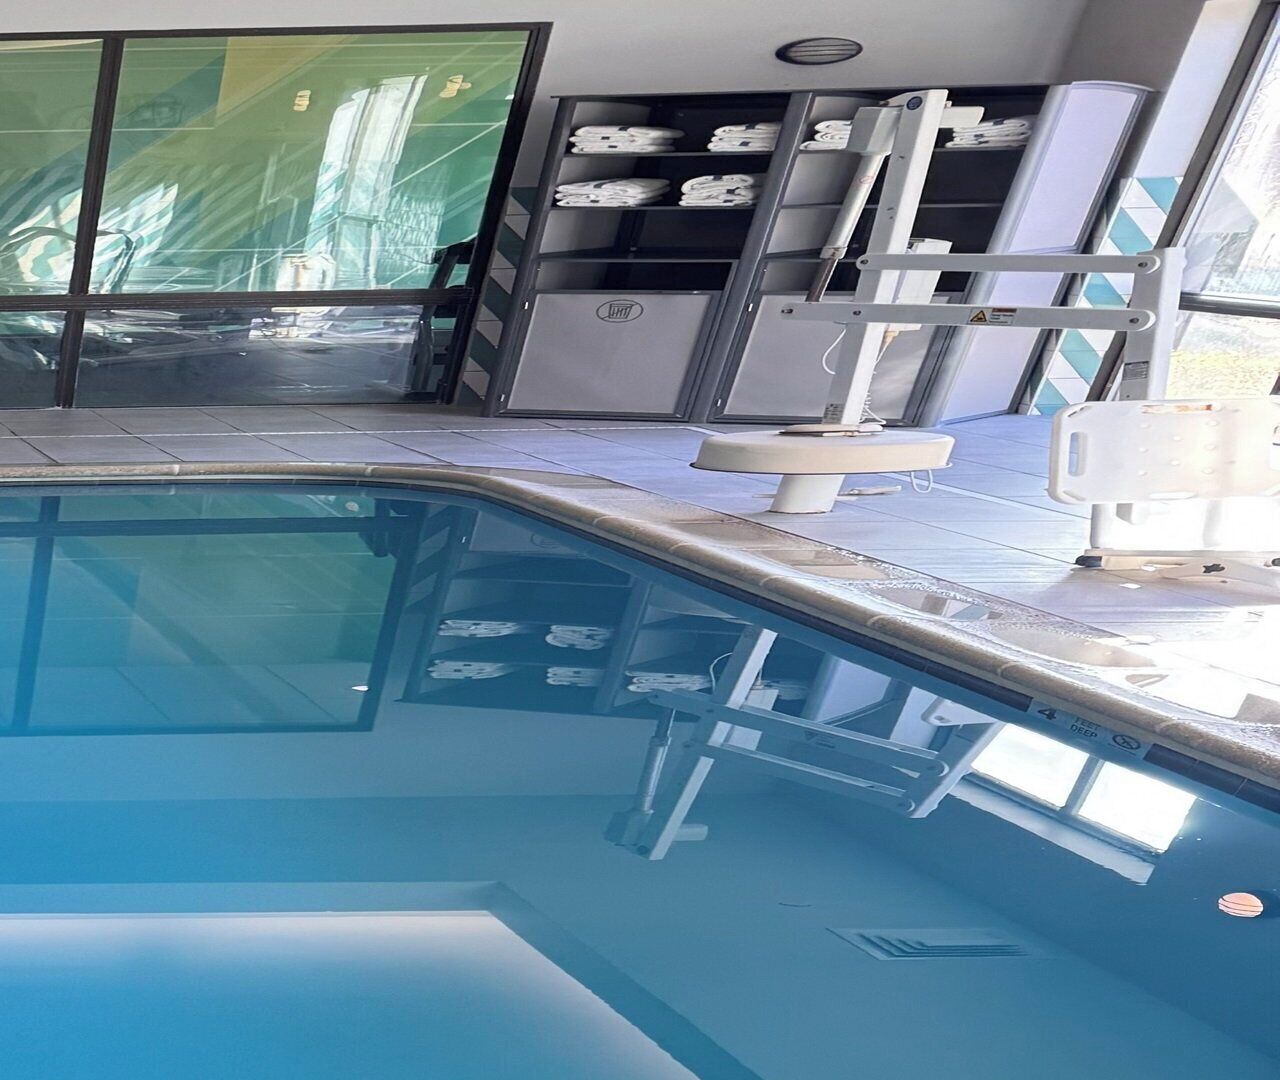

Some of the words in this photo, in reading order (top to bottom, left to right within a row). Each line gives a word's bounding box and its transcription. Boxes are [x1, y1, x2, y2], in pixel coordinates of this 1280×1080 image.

[1037, 708, 1057, 720] 4
[1074, 717, 1101, 730] FEET
[1070, 724, 1098, 738] DEEP
